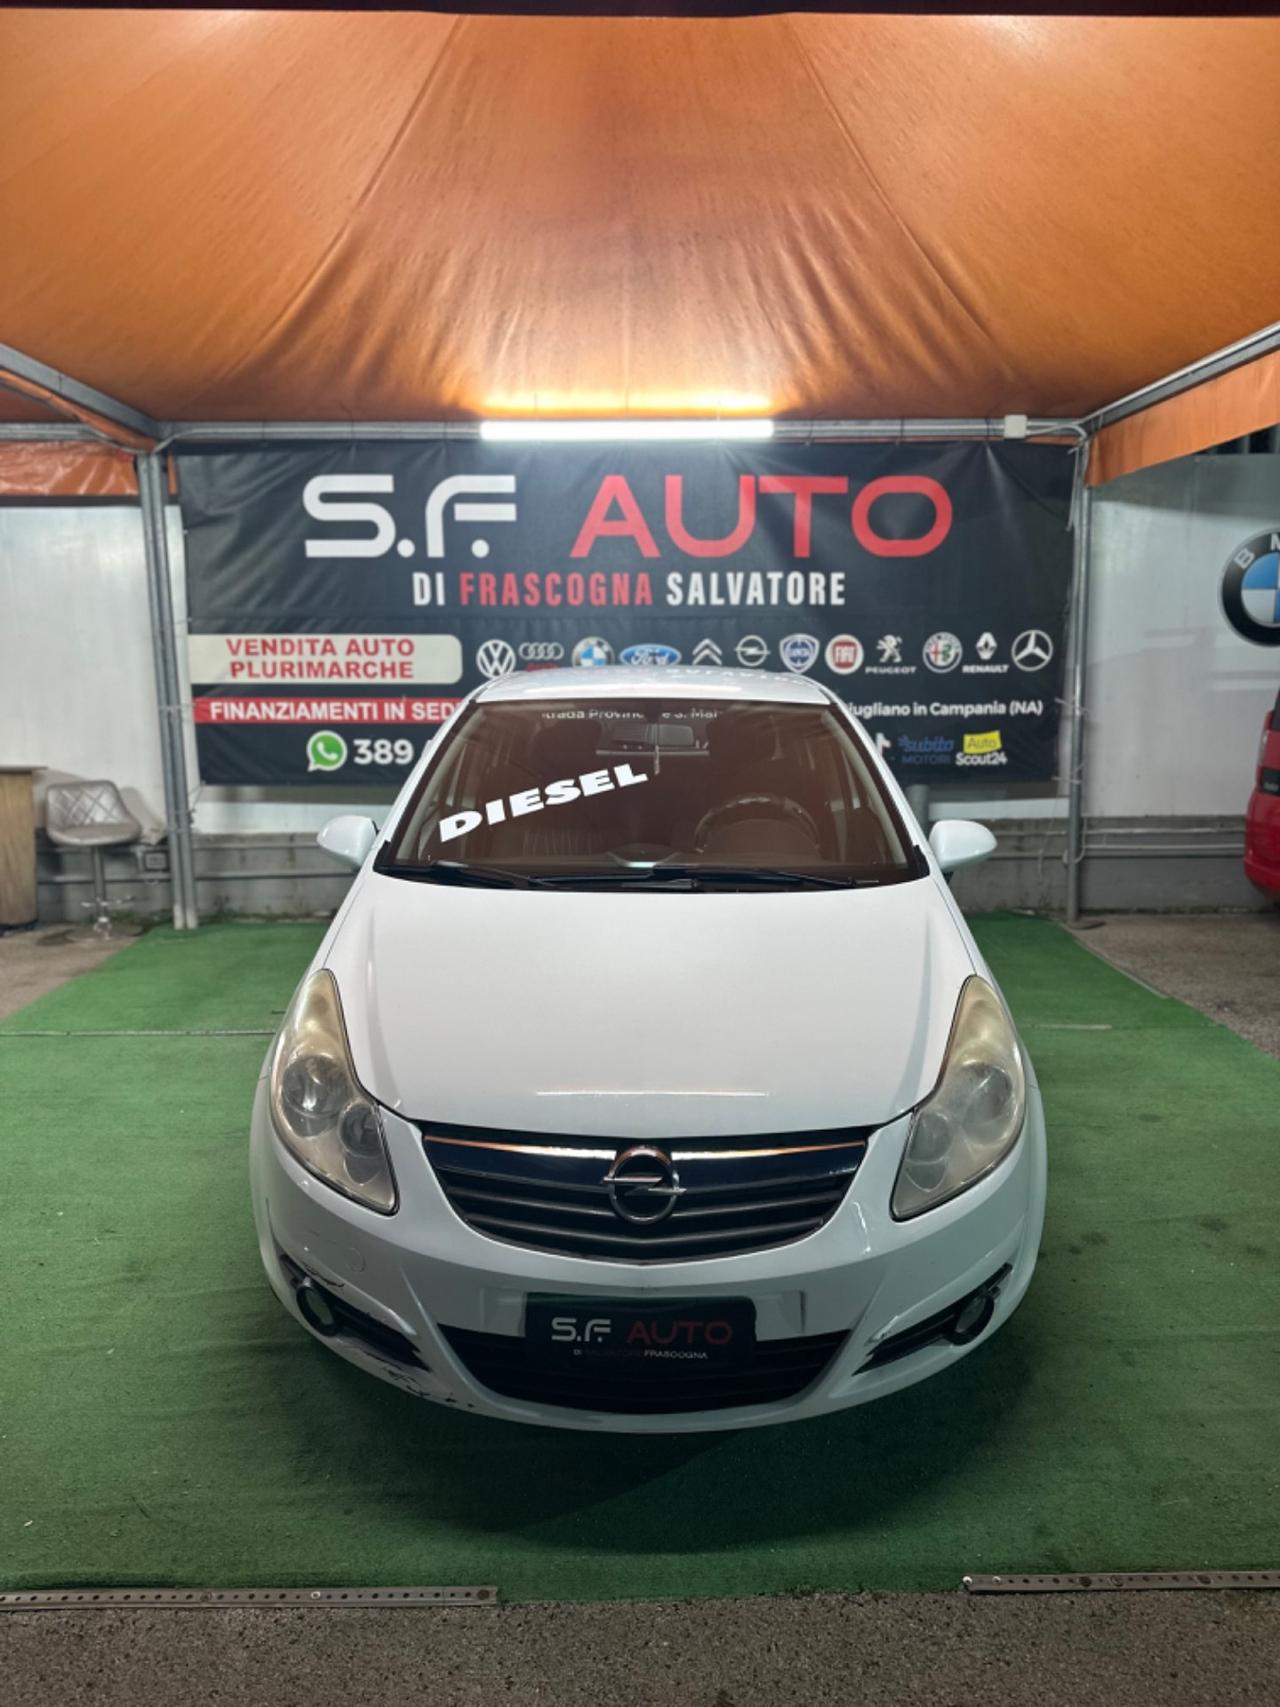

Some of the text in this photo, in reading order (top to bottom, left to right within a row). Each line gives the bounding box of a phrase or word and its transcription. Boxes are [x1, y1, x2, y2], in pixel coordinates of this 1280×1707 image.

[569, 474, 953, 558] AUTO
[413, 571, 847, 607] DI FRASCOGNA SALVATORE
[226, 638, 415, 657] VENDITA AUTO
[230, 661, 414, 679] PLURIMARCHE
[865, 666, 917, 675] PEUGEOT
[962, 664, 1009, 674] RENAULT
[210, 701, 461, 721] FINANZIAMENTI IN SED
[848, 700, 1043, 719] iugliano in Campania (NA)
[353, 738, 414, 765] 389
[967, 737, 998, 751] Auto
[955, 752, 1008, 766] Scout24
[439, 763, 648, 843] DIESEL
[626, 1320, 734, 1345] AUTO
